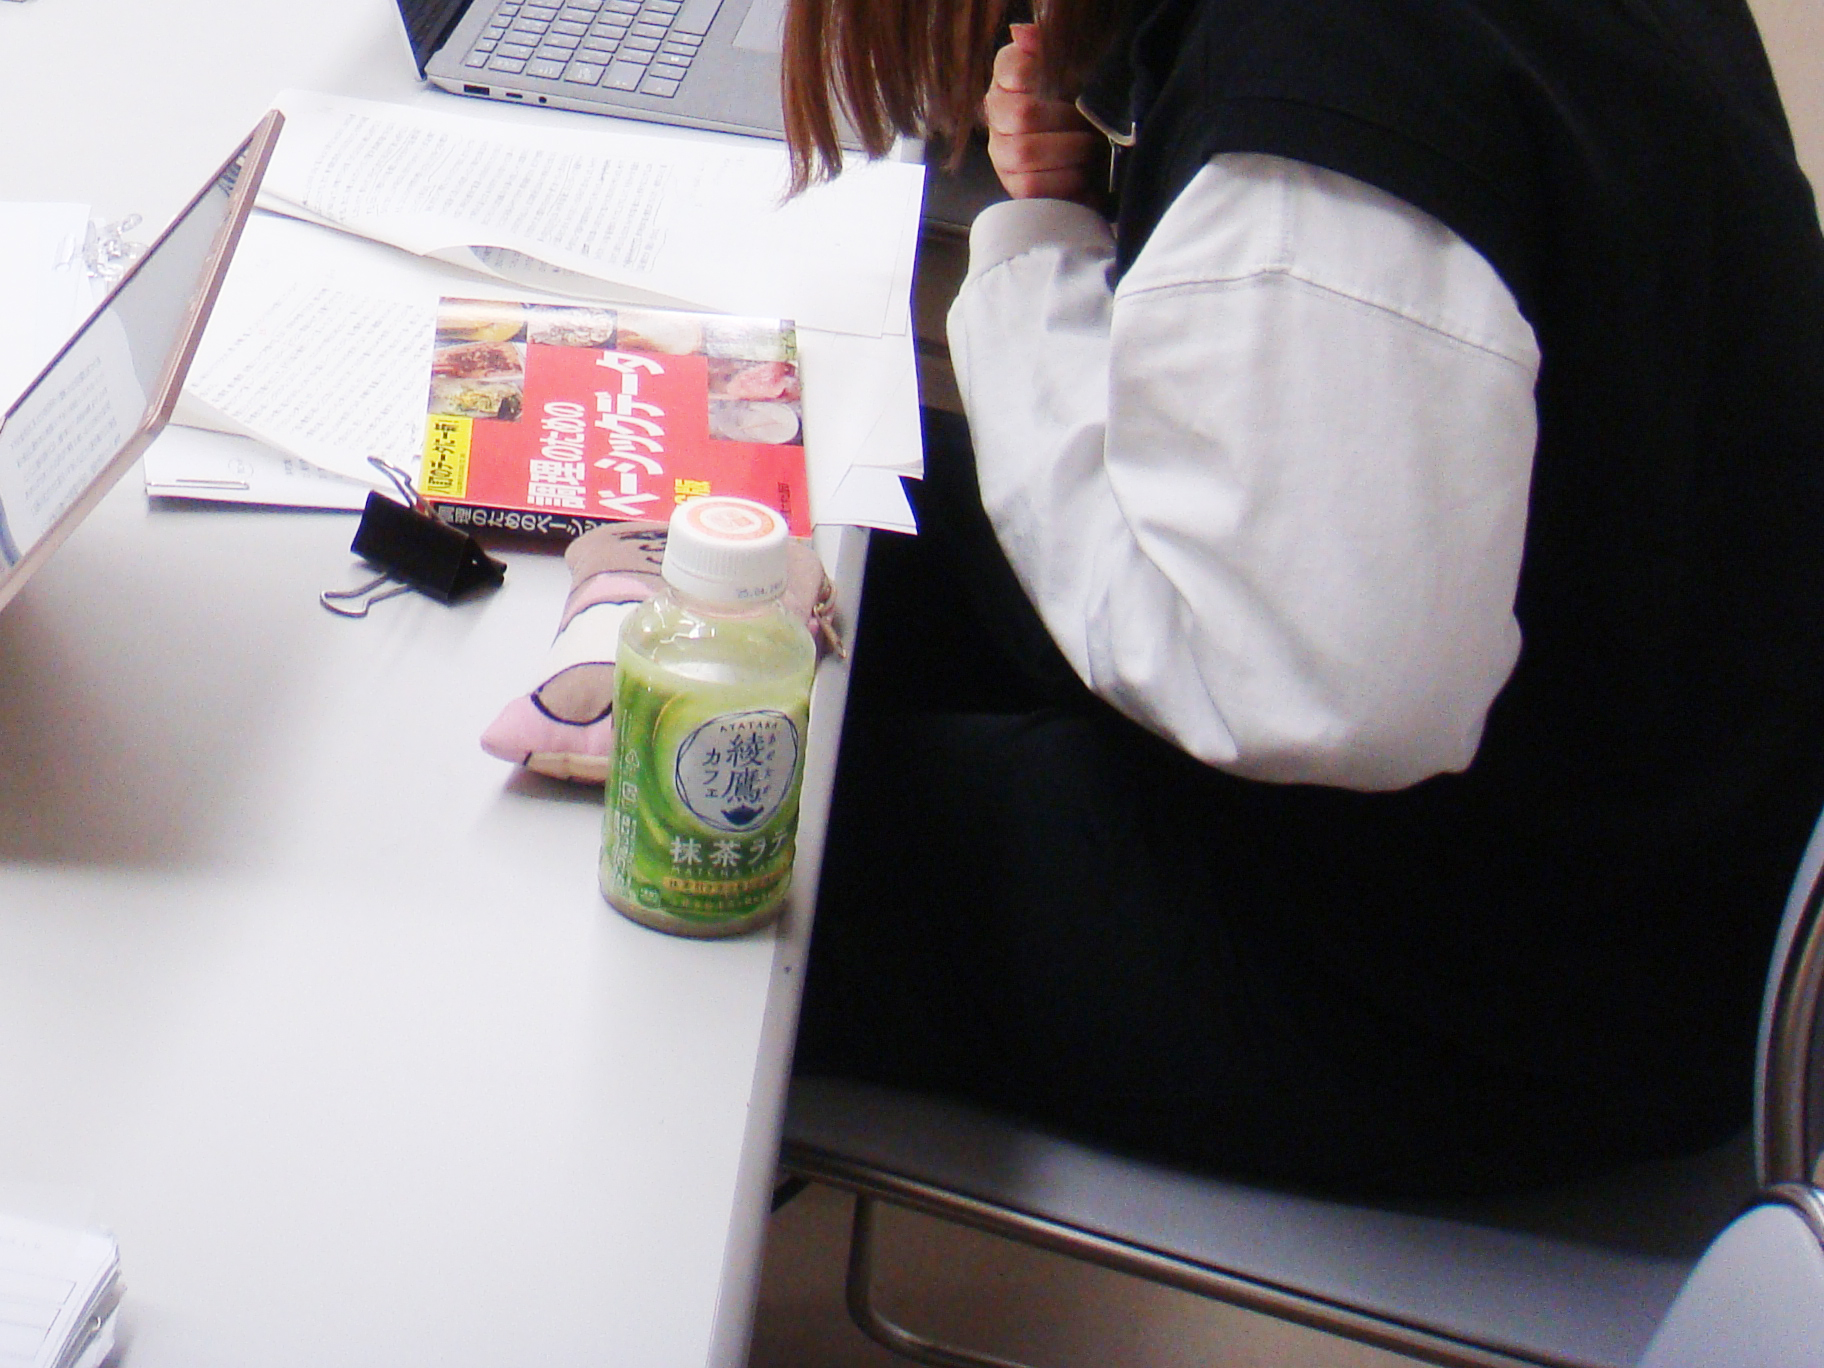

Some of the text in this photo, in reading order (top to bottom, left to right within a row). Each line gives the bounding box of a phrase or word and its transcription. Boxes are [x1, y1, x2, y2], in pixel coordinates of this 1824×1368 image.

[527, 401, 587, 509] 調理のための
[594, 350, 665, 516] ベーシックデータ
[702, 747, 722, 799] カフェ
[721, 732, 765, 804] 綾鷹
[669, 830, 788, 867] 抹茶ラテ
